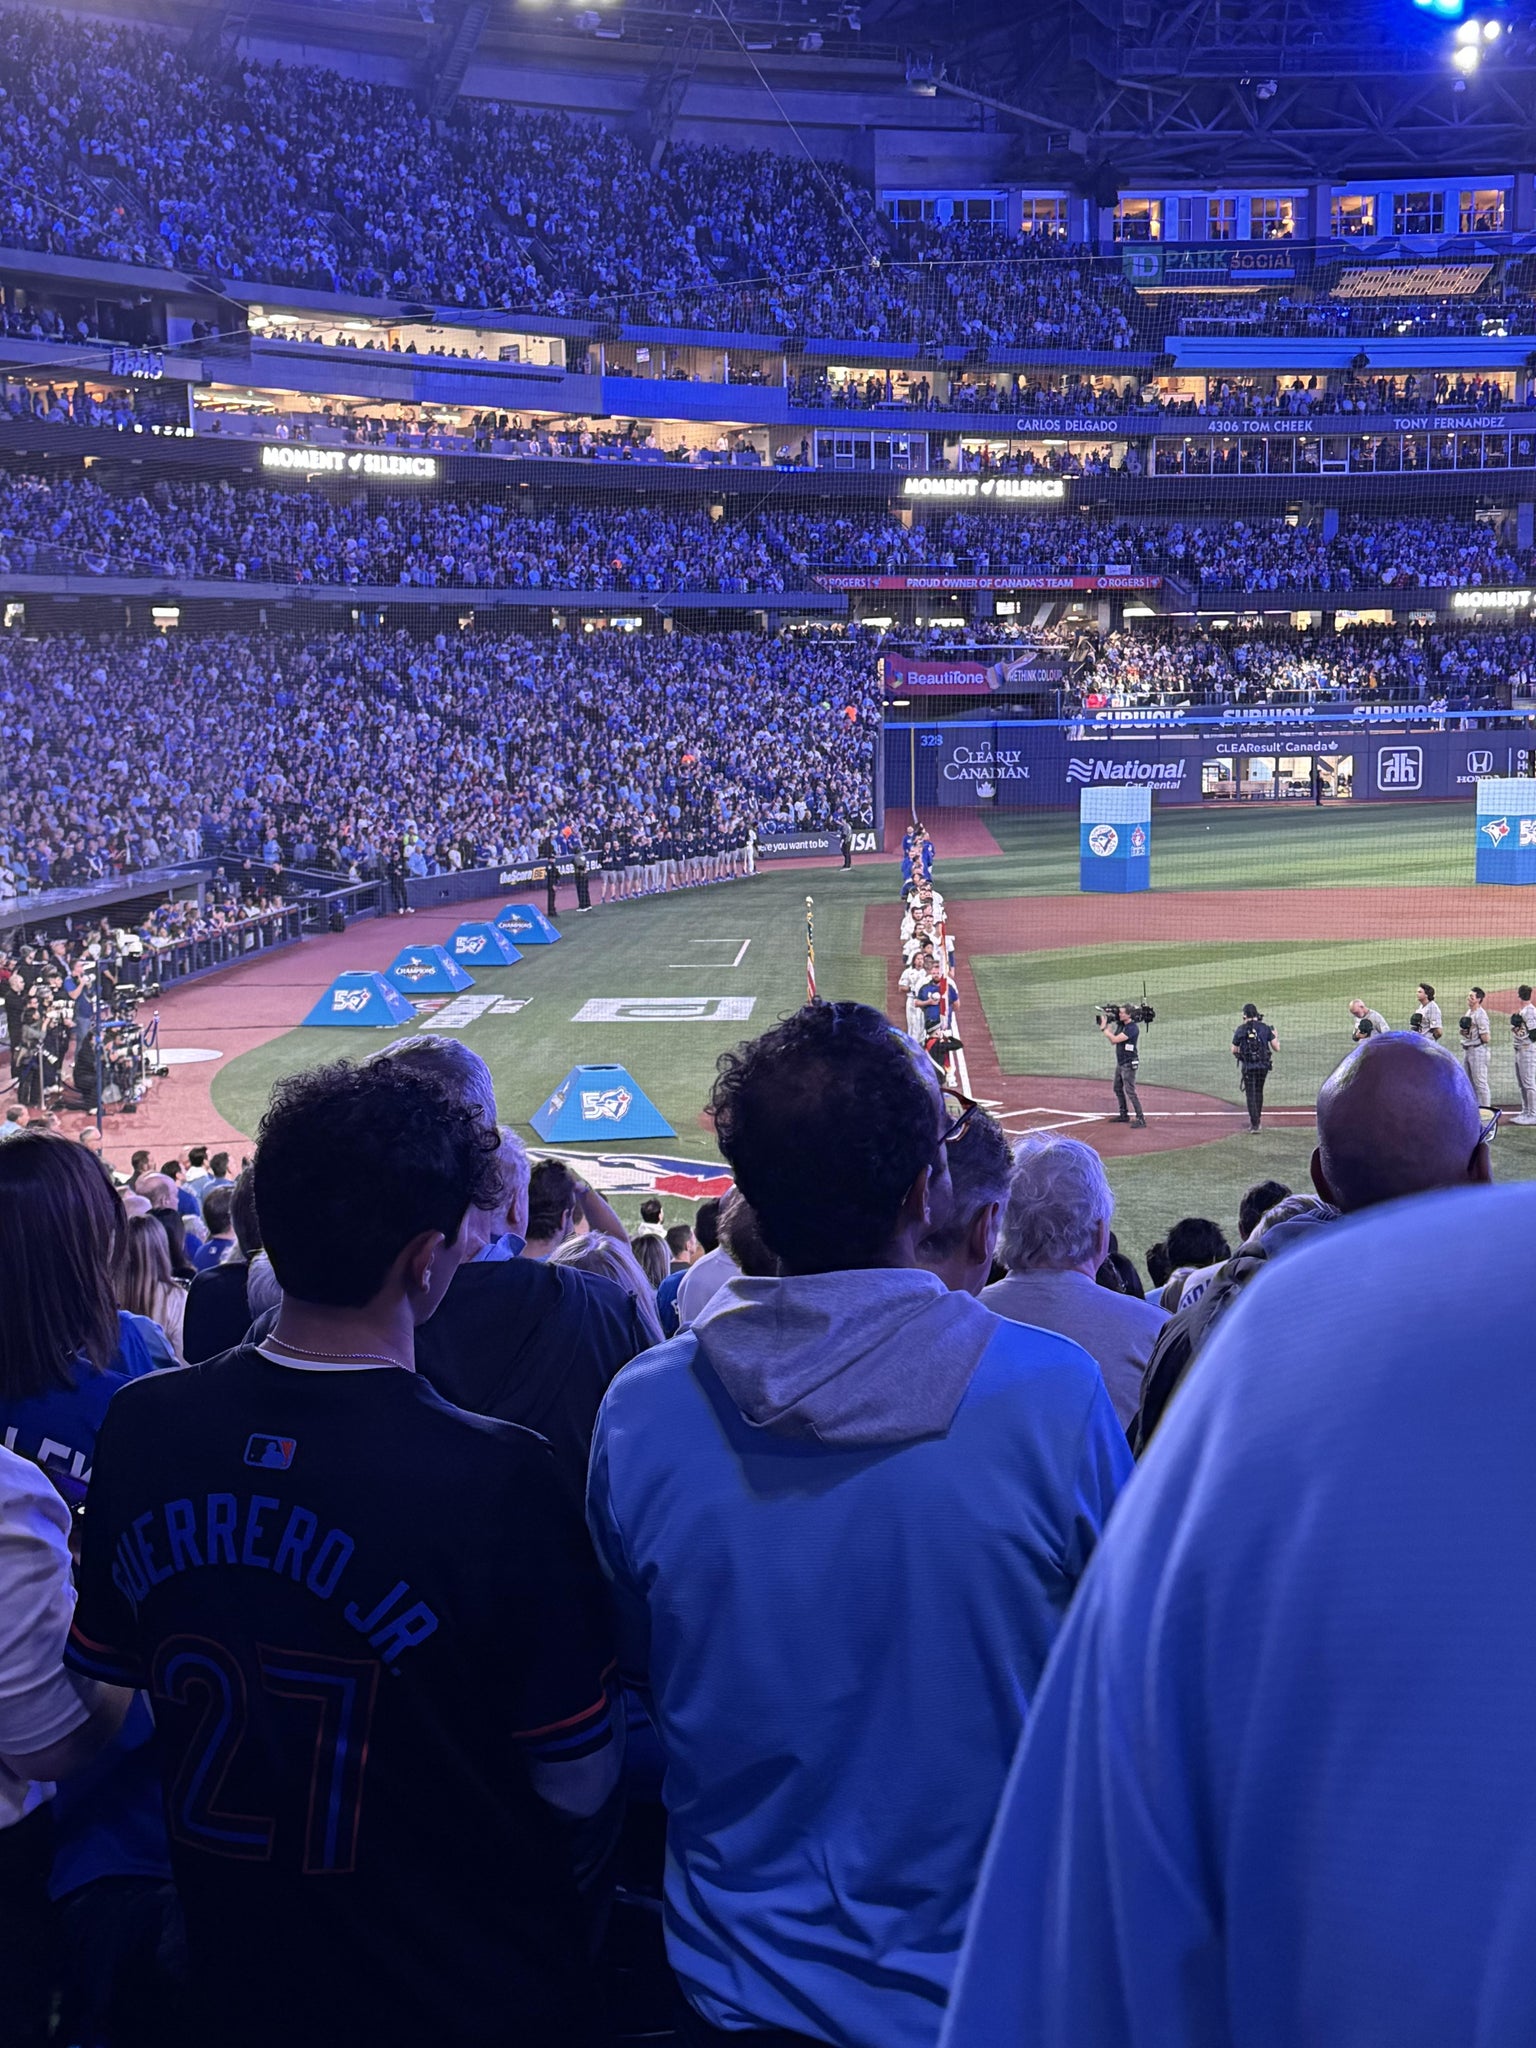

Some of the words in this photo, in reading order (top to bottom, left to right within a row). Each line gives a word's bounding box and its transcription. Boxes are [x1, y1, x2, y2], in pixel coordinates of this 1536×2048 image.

[1132, 255, 1158, 277] TD
[1165, 250, 1227, 268] PARK
[1231, 254, 1294, 268] SOCIAL
[112, 360, 163, 380] KPMG
[1017, 420, 1060, 431] CARLOS
[1065, 421, 1117, 431] DELGADO
[1208, 421, 1239, 432] 4306
[1242, 421, 1270, 432] TOM
[1274, 421, 1312, 431] CHEEK
[1394, 418, 1428, 430] TONY
[1434, 417, 1504, 429] FERNANDEZ
[262, 447, 346, 471] MOMENT
[364, 454, 436, 476] SILENCE
[904, 478, 978, 495] MOMENT
[996, 481, 1064, 496] SILENCE
[829, 578, 866, 588] ROGERS
[907, 579, 938, 588] PROUD
[942, 579, 976, 588] OWNER
[979, 579, 993, 588] OF
[994, 579, 1044, 588] CANADA'S
[1047, 579, 1074, 588] TEAM
[1109, 578, 1145, 587] ROGERS
[1454, 591, 1532, 607] MOMENT
[908, 671, 984, 685] BeautiTone
[921, 736, 943, 746] 328
[1286, 740, 1328, 751] Canada
[953, 746, 1021, 766] CLEARLY
[943, 763, 1030, 780] CANADIAN
[1147, 780, 1180, 789] Rental
[773, 842, 788, 853] you
[789, 840, 808, 850] want
[809, 840, 818, 849] to
[818, 838, 829, 848] be
[395, 967, 436, 976] CHAMPIONS
[111, 1492, 355, 1625] GUERRERO
[343, 1579, 440, 1677] JR.
[151, 1633, 381, 1876] 27
